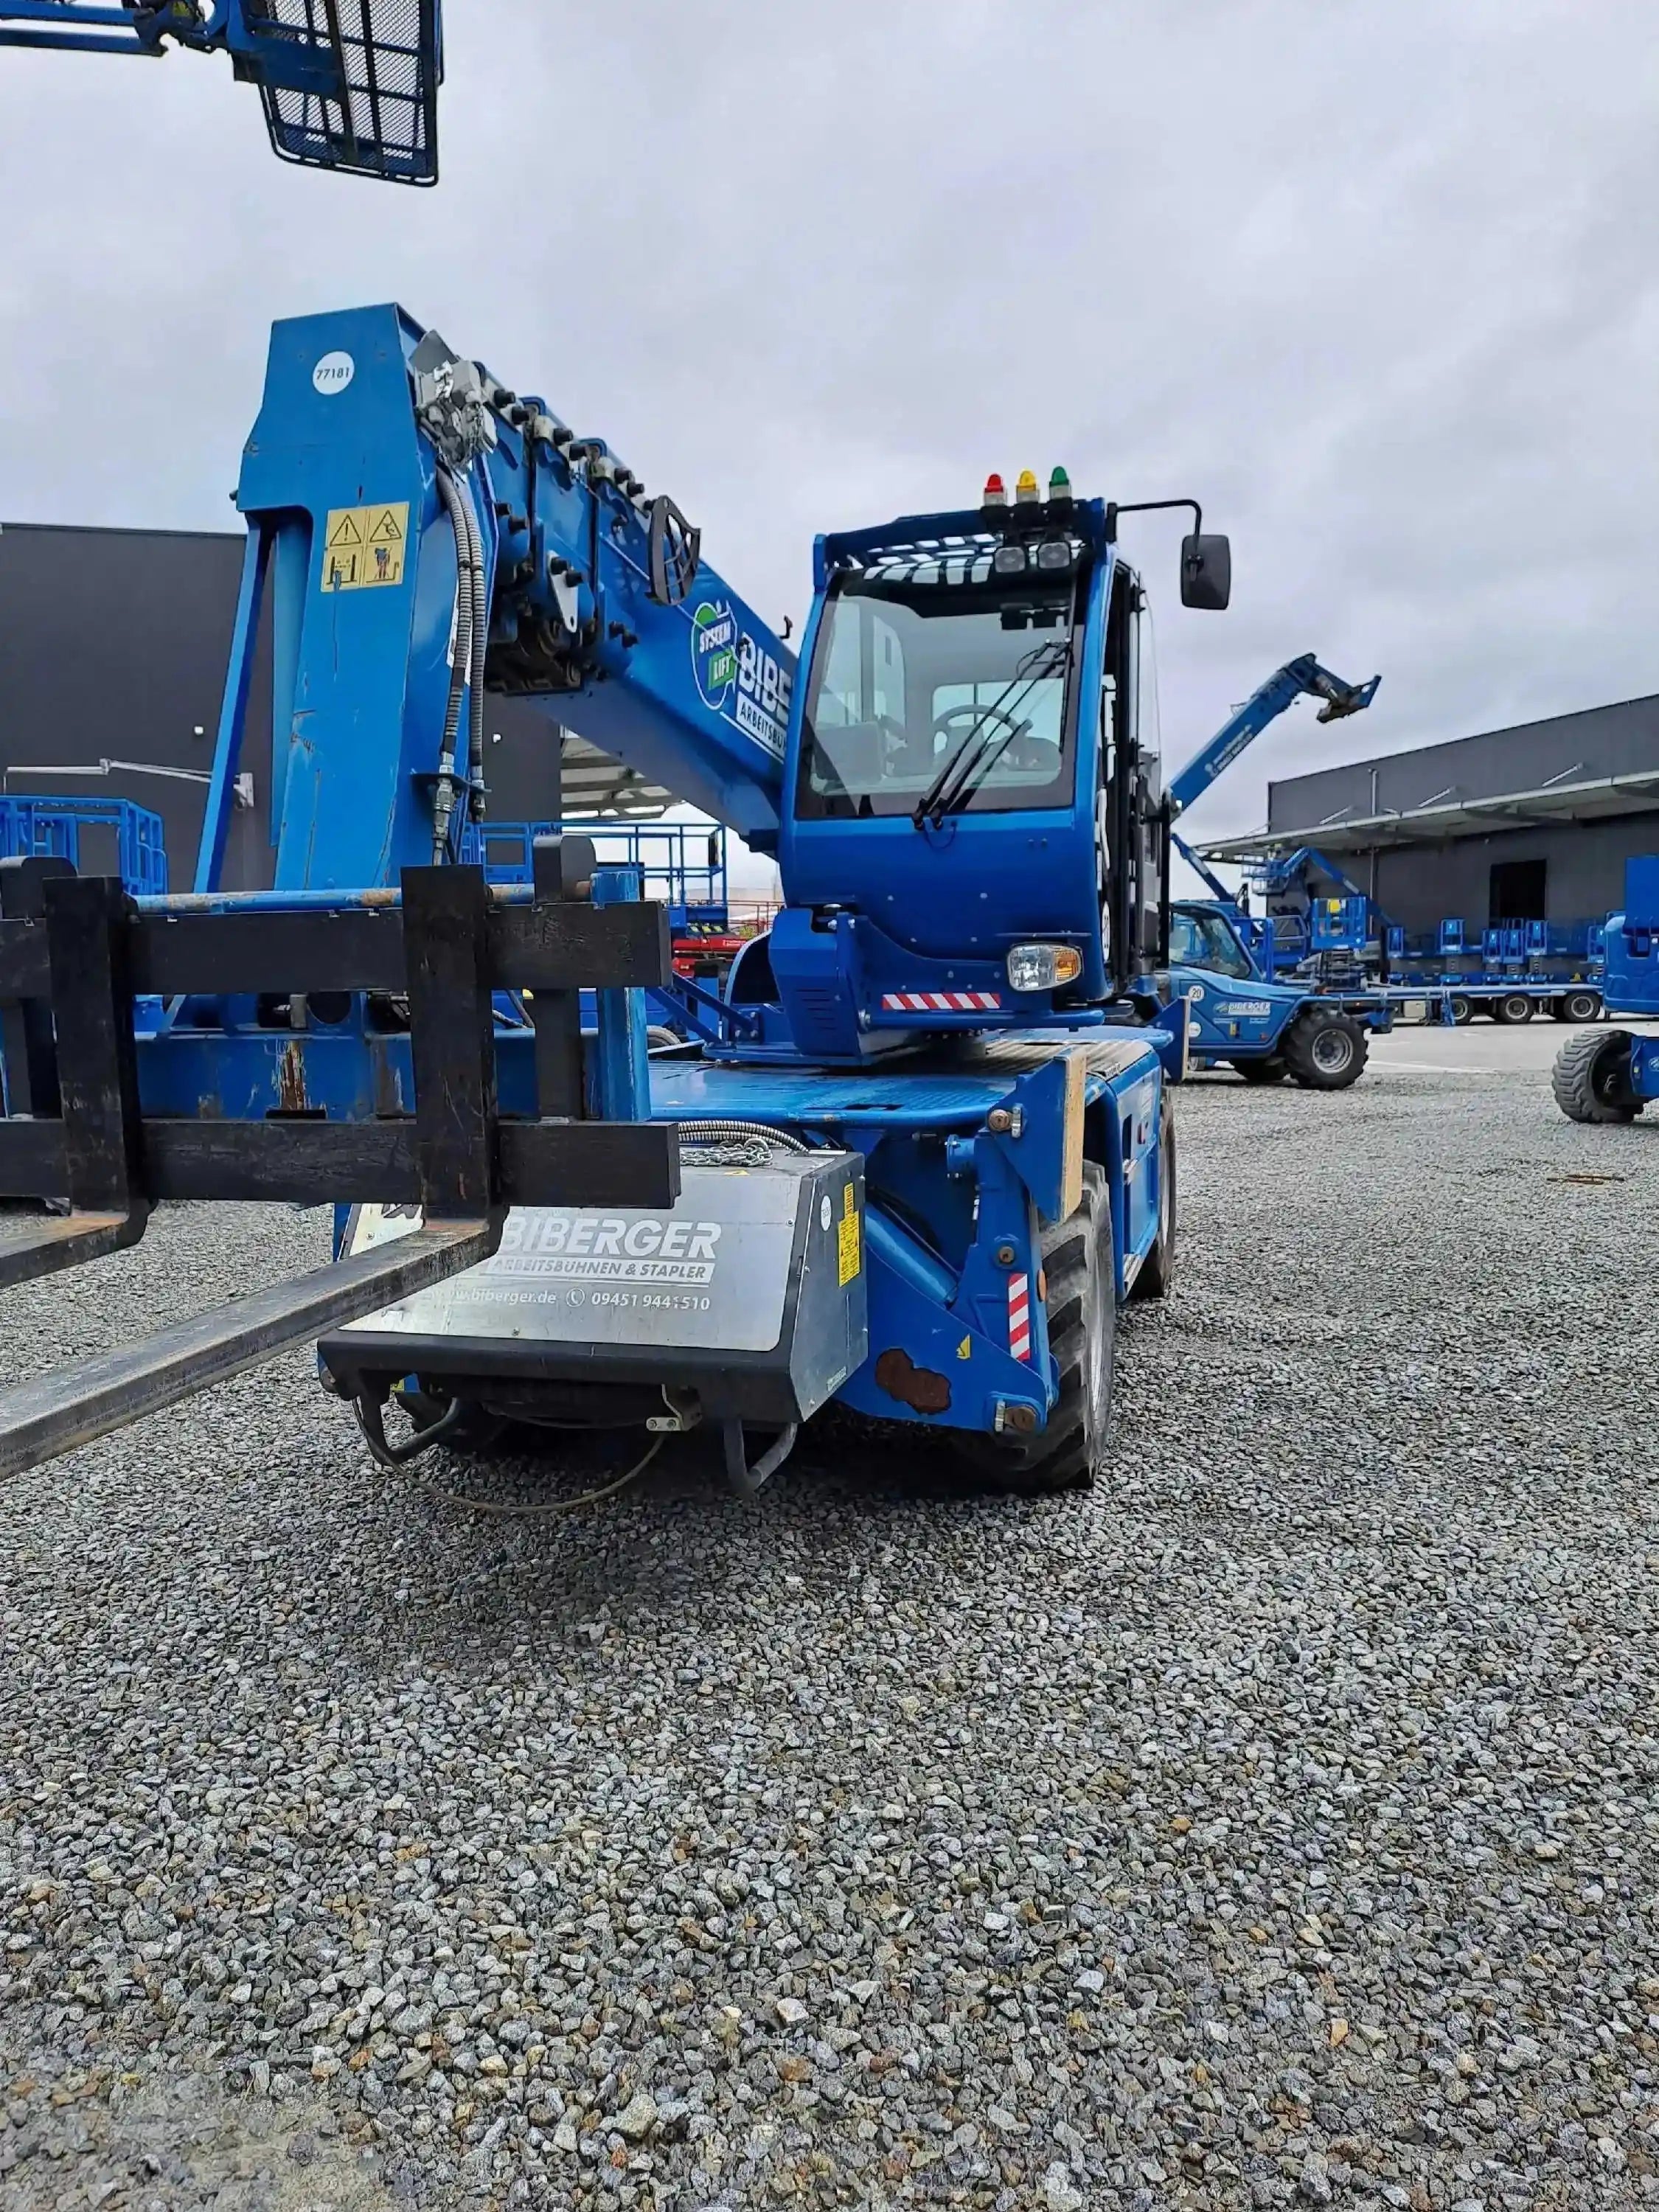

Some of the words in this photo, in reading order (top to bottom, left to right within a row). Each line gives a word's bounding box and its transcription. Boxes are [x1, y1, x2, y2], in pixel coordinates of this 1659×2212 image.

[316, 366, 349, 380] 77181
[713, 654, 732, 681] LIFT
[500, 1217, 722, 1259] BIBERGER
[493, 1259, 622, 1275] ARBEITSBÜHNEN
[625, 1263, 636, 1276] &
[639, 1263, 706, 1279] STAPLER
[591, 1292, 638, 1307] 09451
